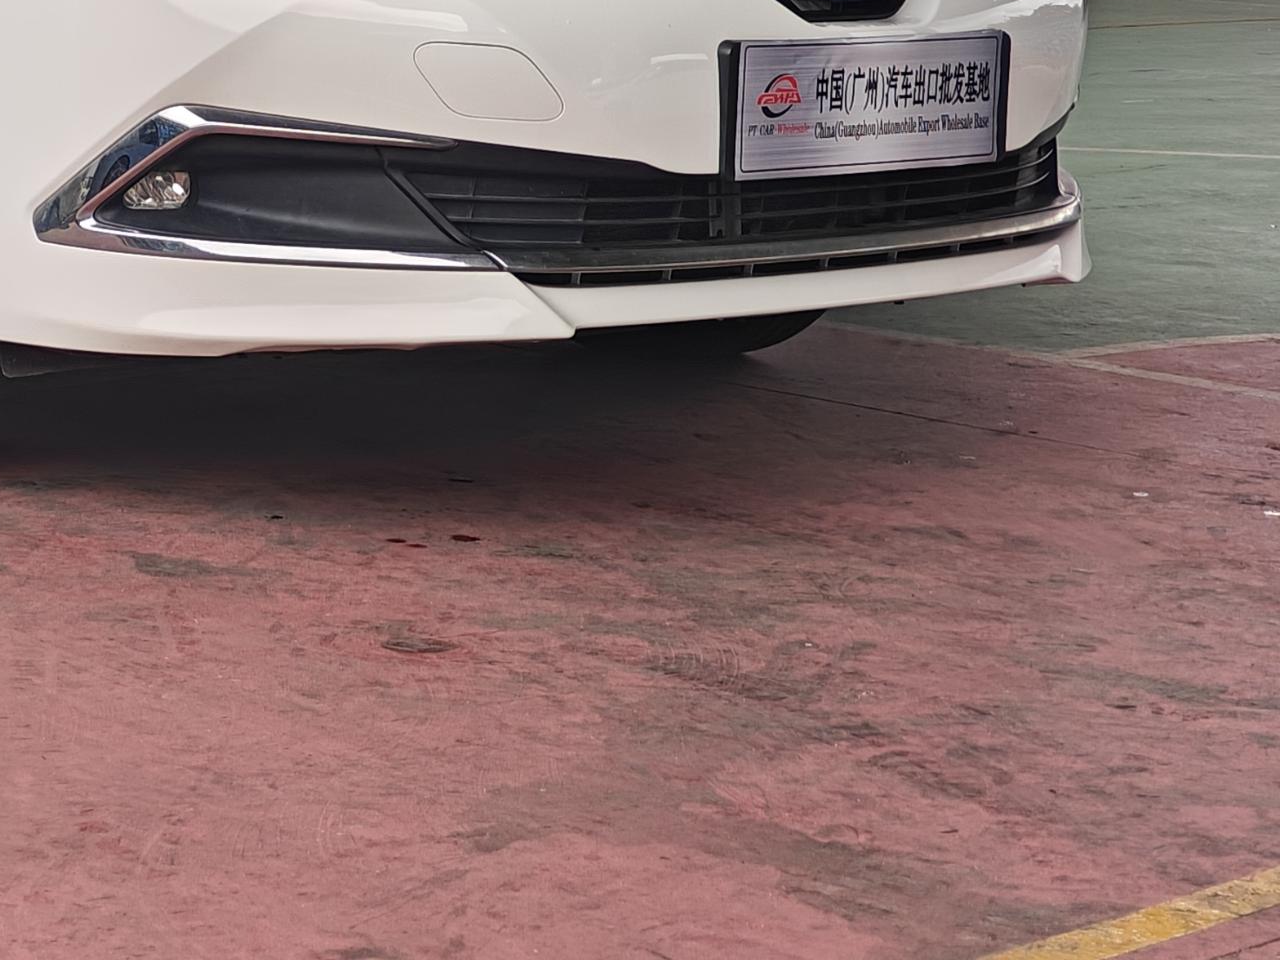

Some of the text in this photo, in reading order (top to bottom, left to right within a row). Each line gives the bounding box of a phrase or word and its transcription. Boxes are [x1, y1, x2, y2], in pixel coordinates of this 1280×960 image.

[816, 61, 991, 115] 中国(广州)汽车出口批发基地
[748, 125, 758, 136] PT
[760, 124, 775, 136] CAR
[918, 116, 940, 136] Export
[941, 113, 973, 130] Wholesale
[974, 112, 989, 129] Base
